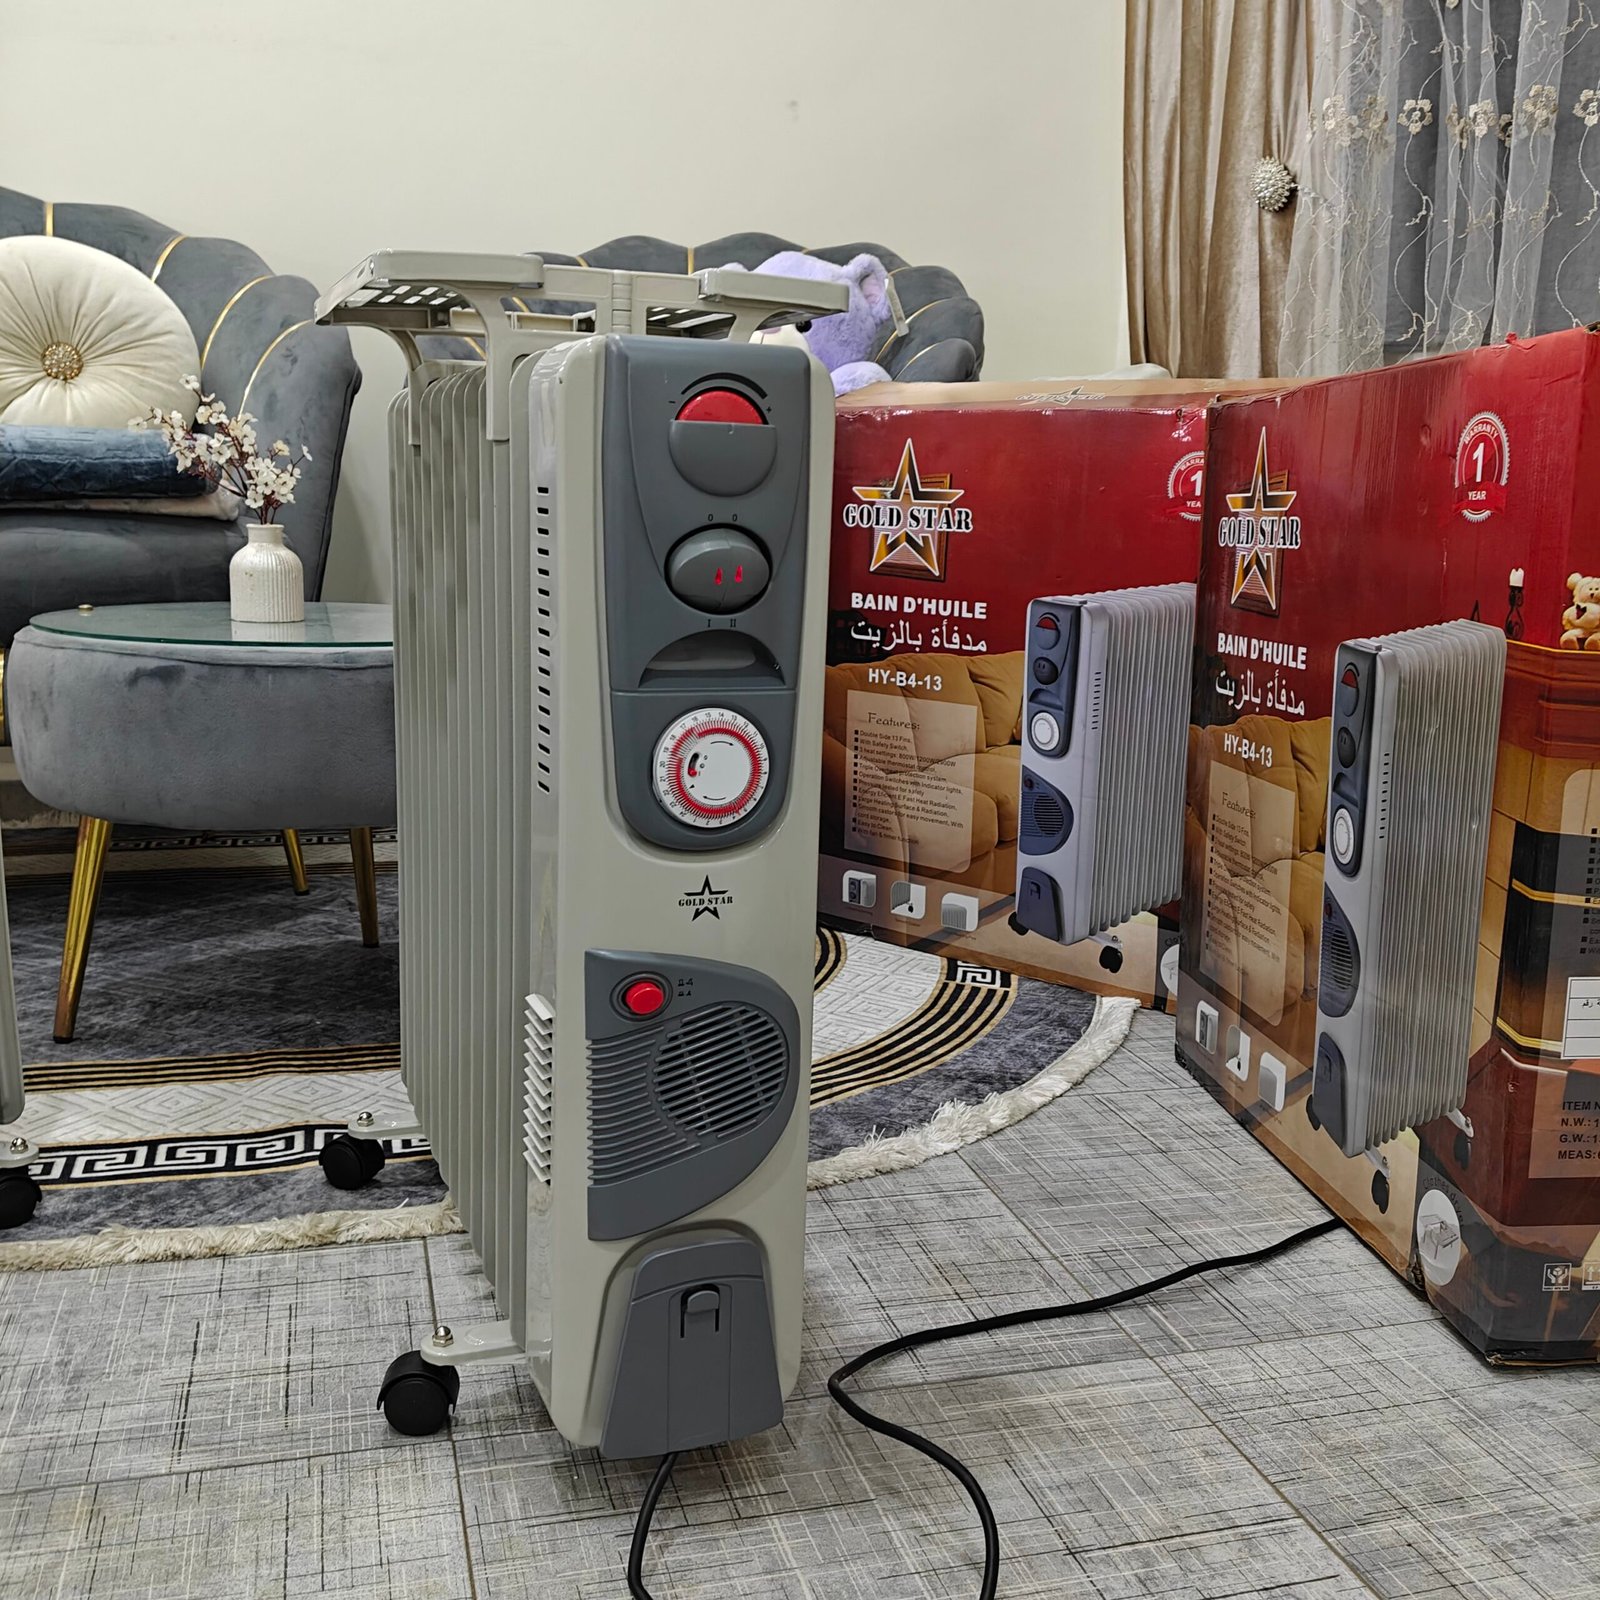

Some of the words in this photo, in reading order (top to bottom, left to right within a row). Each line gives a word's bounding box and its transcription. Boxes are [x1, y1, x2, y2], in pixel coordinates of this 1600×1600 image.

[1464, 424, 1500, 444] WARRANTY
[1180, 458, 1204, 471] WARRA
[1472, 442, 1484, 482] 1
[1191, 470, 1202, 496] 1
[1468, 491, 1486, 500] YEAR
[843, 504, 901, 528] GOLD
[908, 506, 972, 532] STAR
[1218, 516, 1254, 548] GOLD
[1258, 516, 1300, 550] STAR
[852, 593, 898, 612] BAIN
[903, 596, 987, 620] D'HUILE
[850, 620, 922, 652] بالزيت
[932, 618, 988, 653] مدفأة
[1218, 633, 1248, 658] BAIN
[1251, 638, 1307, 670] D'HUILE
[868, 668, 942, 692] HY-B4-13
[1216, 668, 1262, 712] بالزيت
[1266, 669, 1305, 716] مدفأة
[868, 712, 920, 730] Features:
[1224, 732, 1273, 768] HY-B4-13
[1222, 792, 1256, 819] Features:
[678, 898, 705, 907] GOLD
[708, 896, 733, 906] STAR
[1562, 1101, 1590, 1110] ITEM
[1561, 1118, 1590, 1128] N.W.:
[1560, 1134, 1590, 1144] G.W.:
[1558, 1150, 1596, 1160] MEAS:
